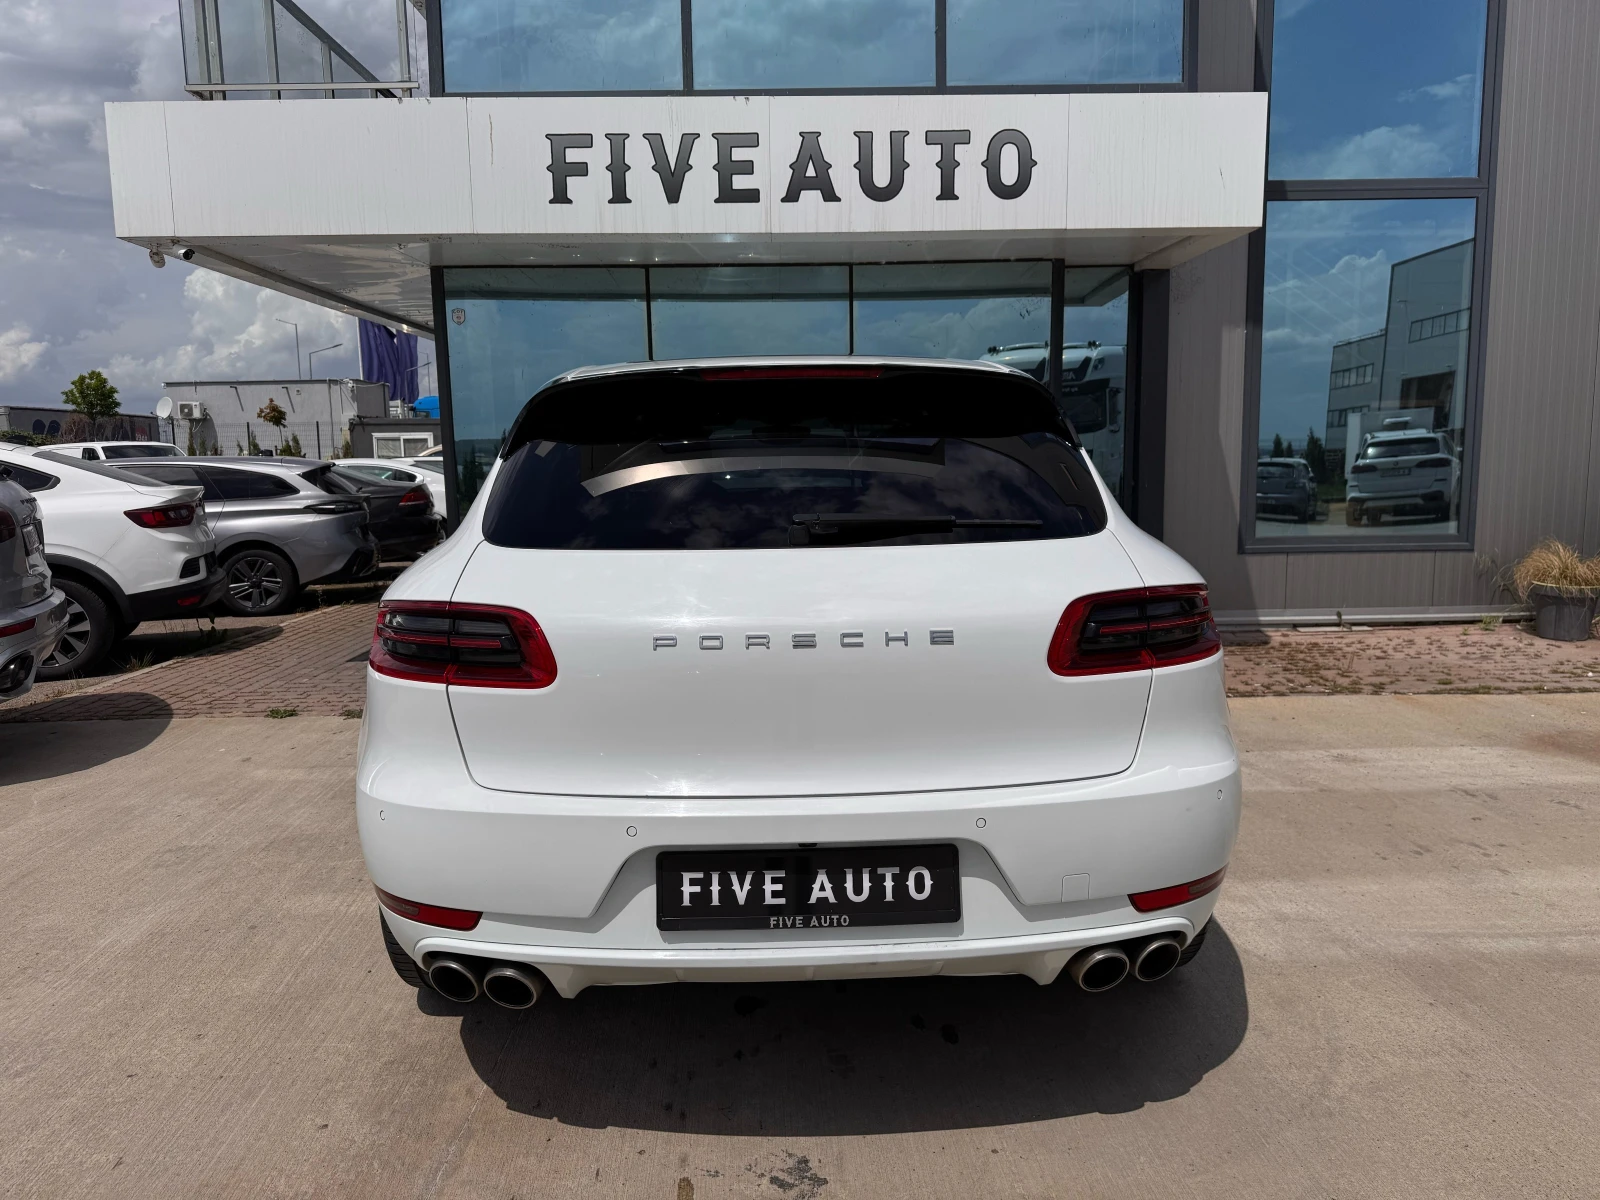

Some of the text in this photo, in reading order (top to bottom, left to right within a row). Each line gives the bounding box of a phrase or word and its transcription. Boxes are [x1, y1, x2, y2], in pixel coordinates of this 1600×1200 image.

[652, 629, 955, 651] PORSCHE
[680, 865, 934, 907] FIVE AUTO
[769, 914, 850, 929] FIVE AUTO
